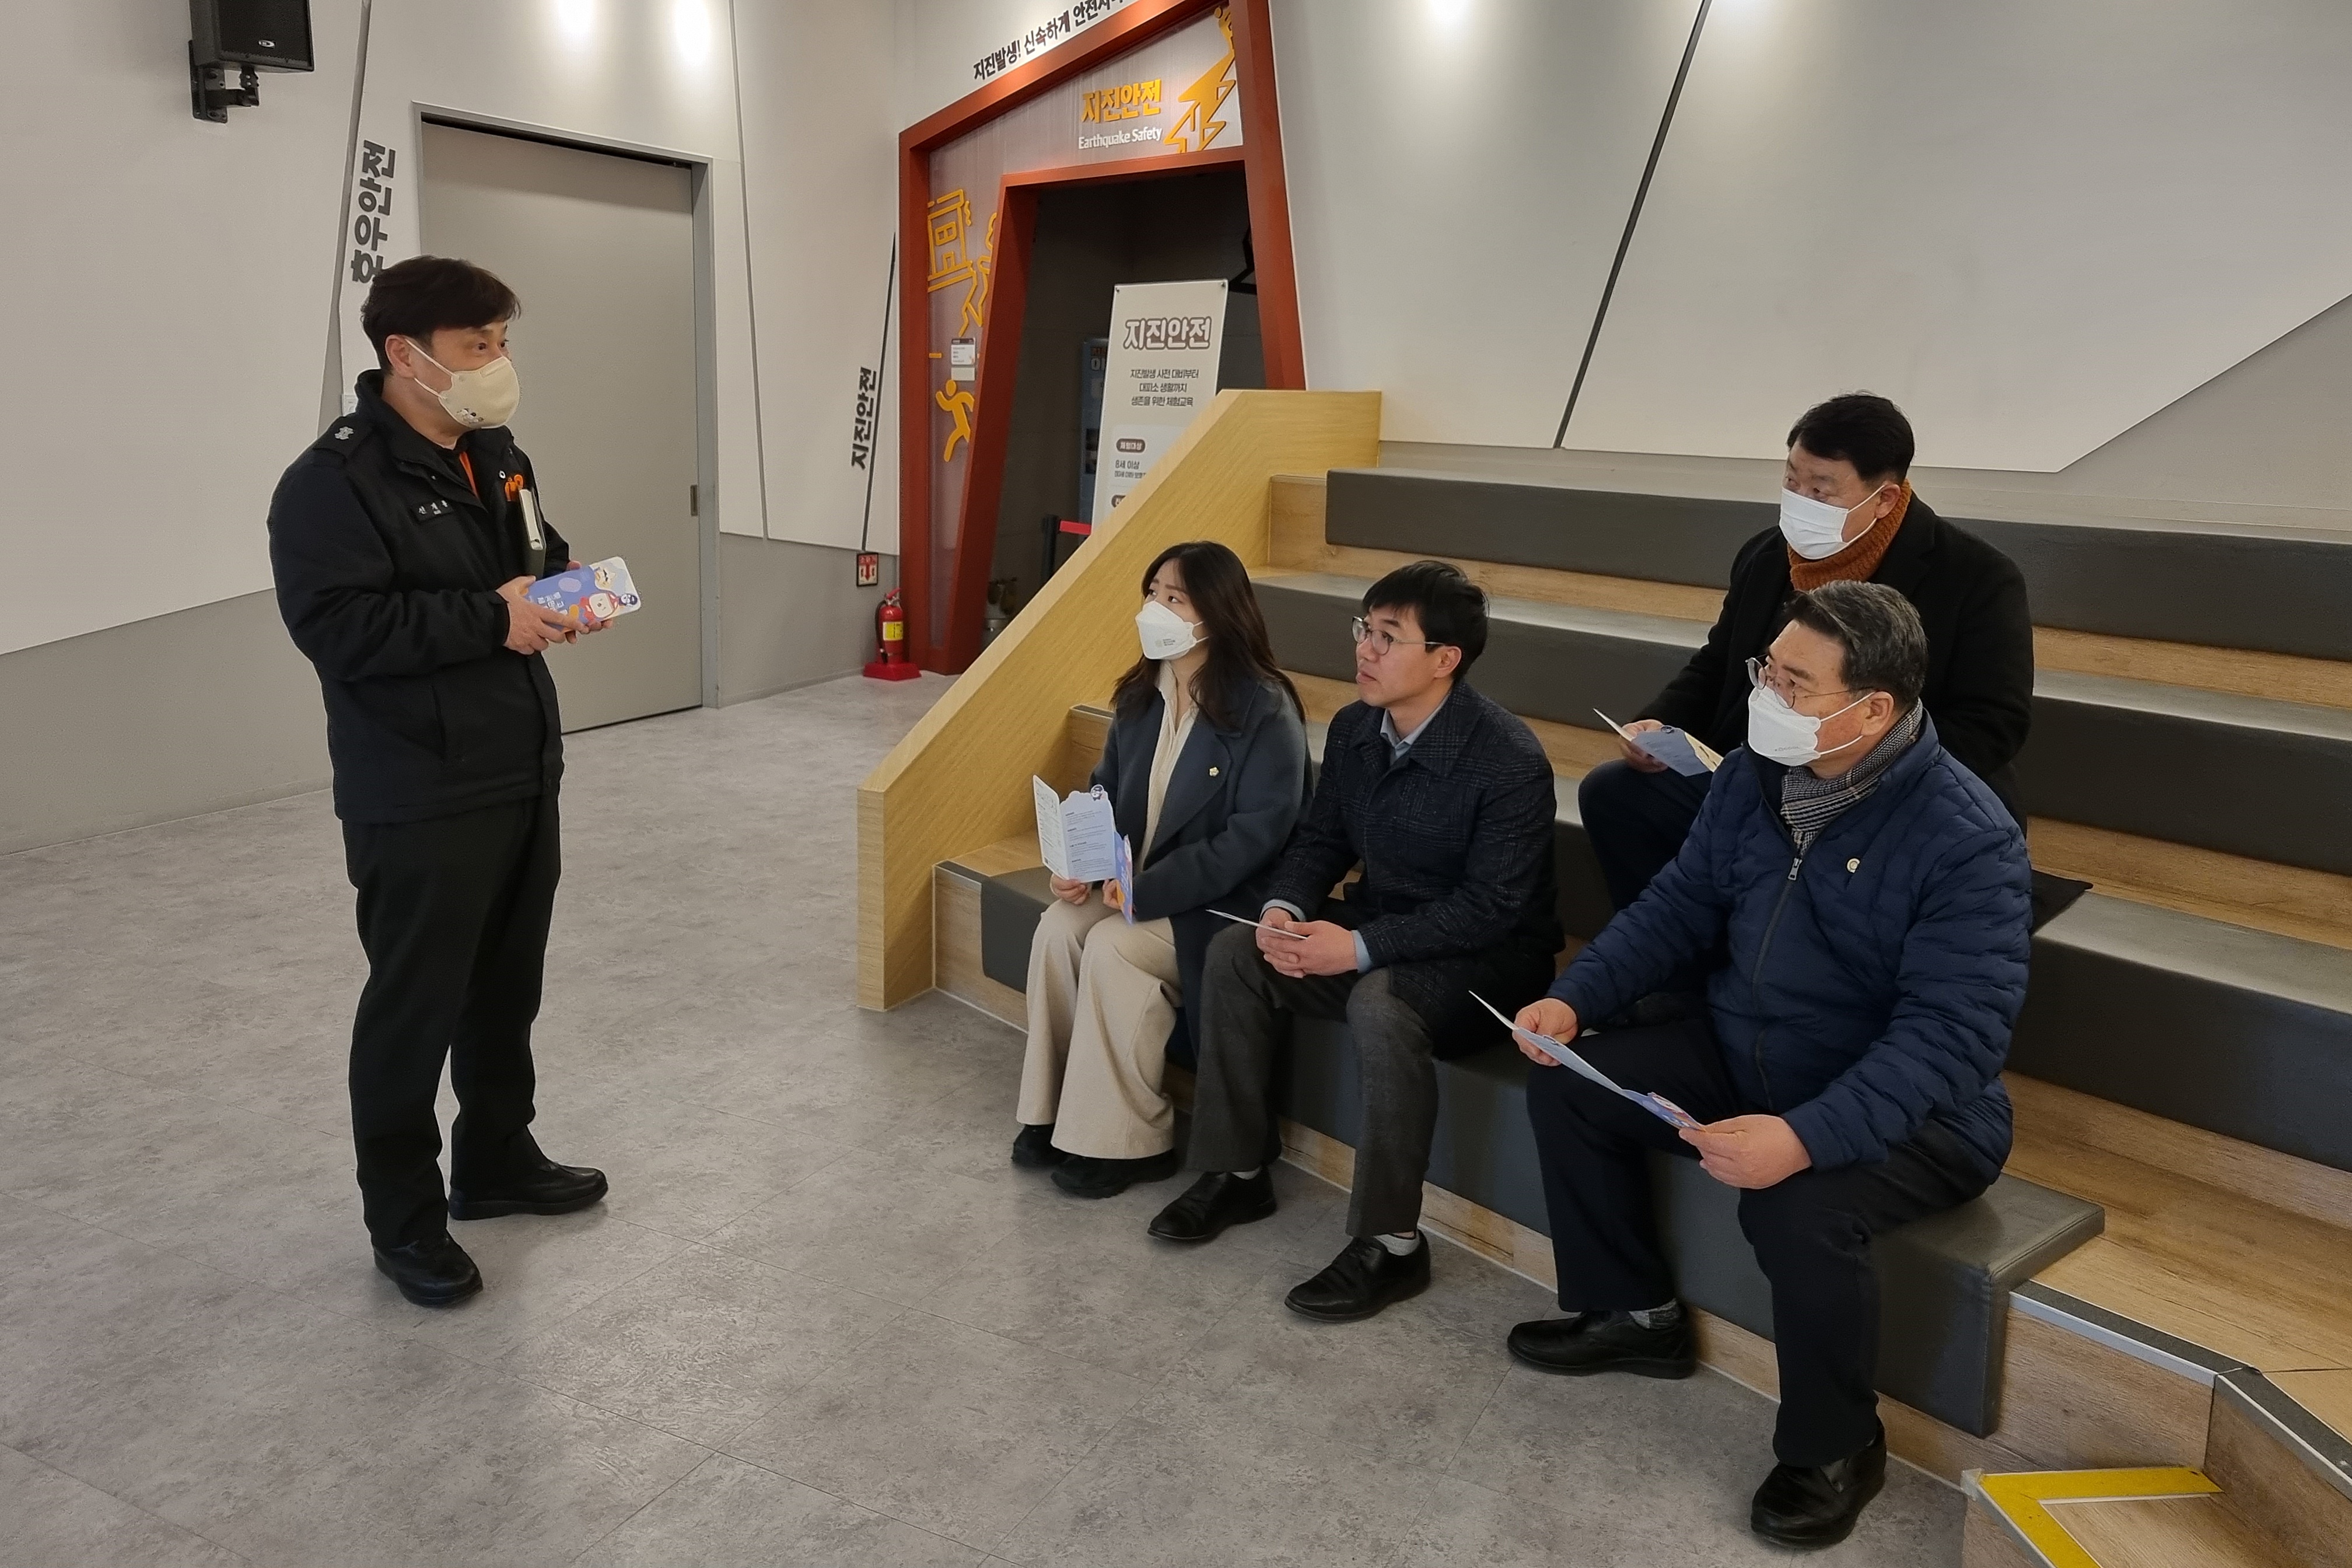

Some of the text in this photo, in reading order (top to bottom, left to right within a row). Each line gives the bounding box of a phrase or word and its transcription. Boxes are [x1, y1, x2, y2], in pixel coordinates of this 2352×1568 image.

[973, 40, 1021, 80] 지진발생!
[1024, 10, 1071, 55] 신속하게
[1080, 79, 1162, 124] 지진안전
[1078, 126, 1163, 150] Earthquake Safety
[351, 139, 396, 284] 호우안전
[1124, 317, 1212, 350] 지진안전
[1130, 369, 1199, 379] 지진발생 사전 대비부터
[1139, 383, 1187, 393] 대피소 생활까지
[1152, 397, 1166, 407] 위한
[1166, 397, 1194, 407] 체험교육
[851, 366, 877, 470] 지진안전
[1127, 460, 1140, 470] 이상
